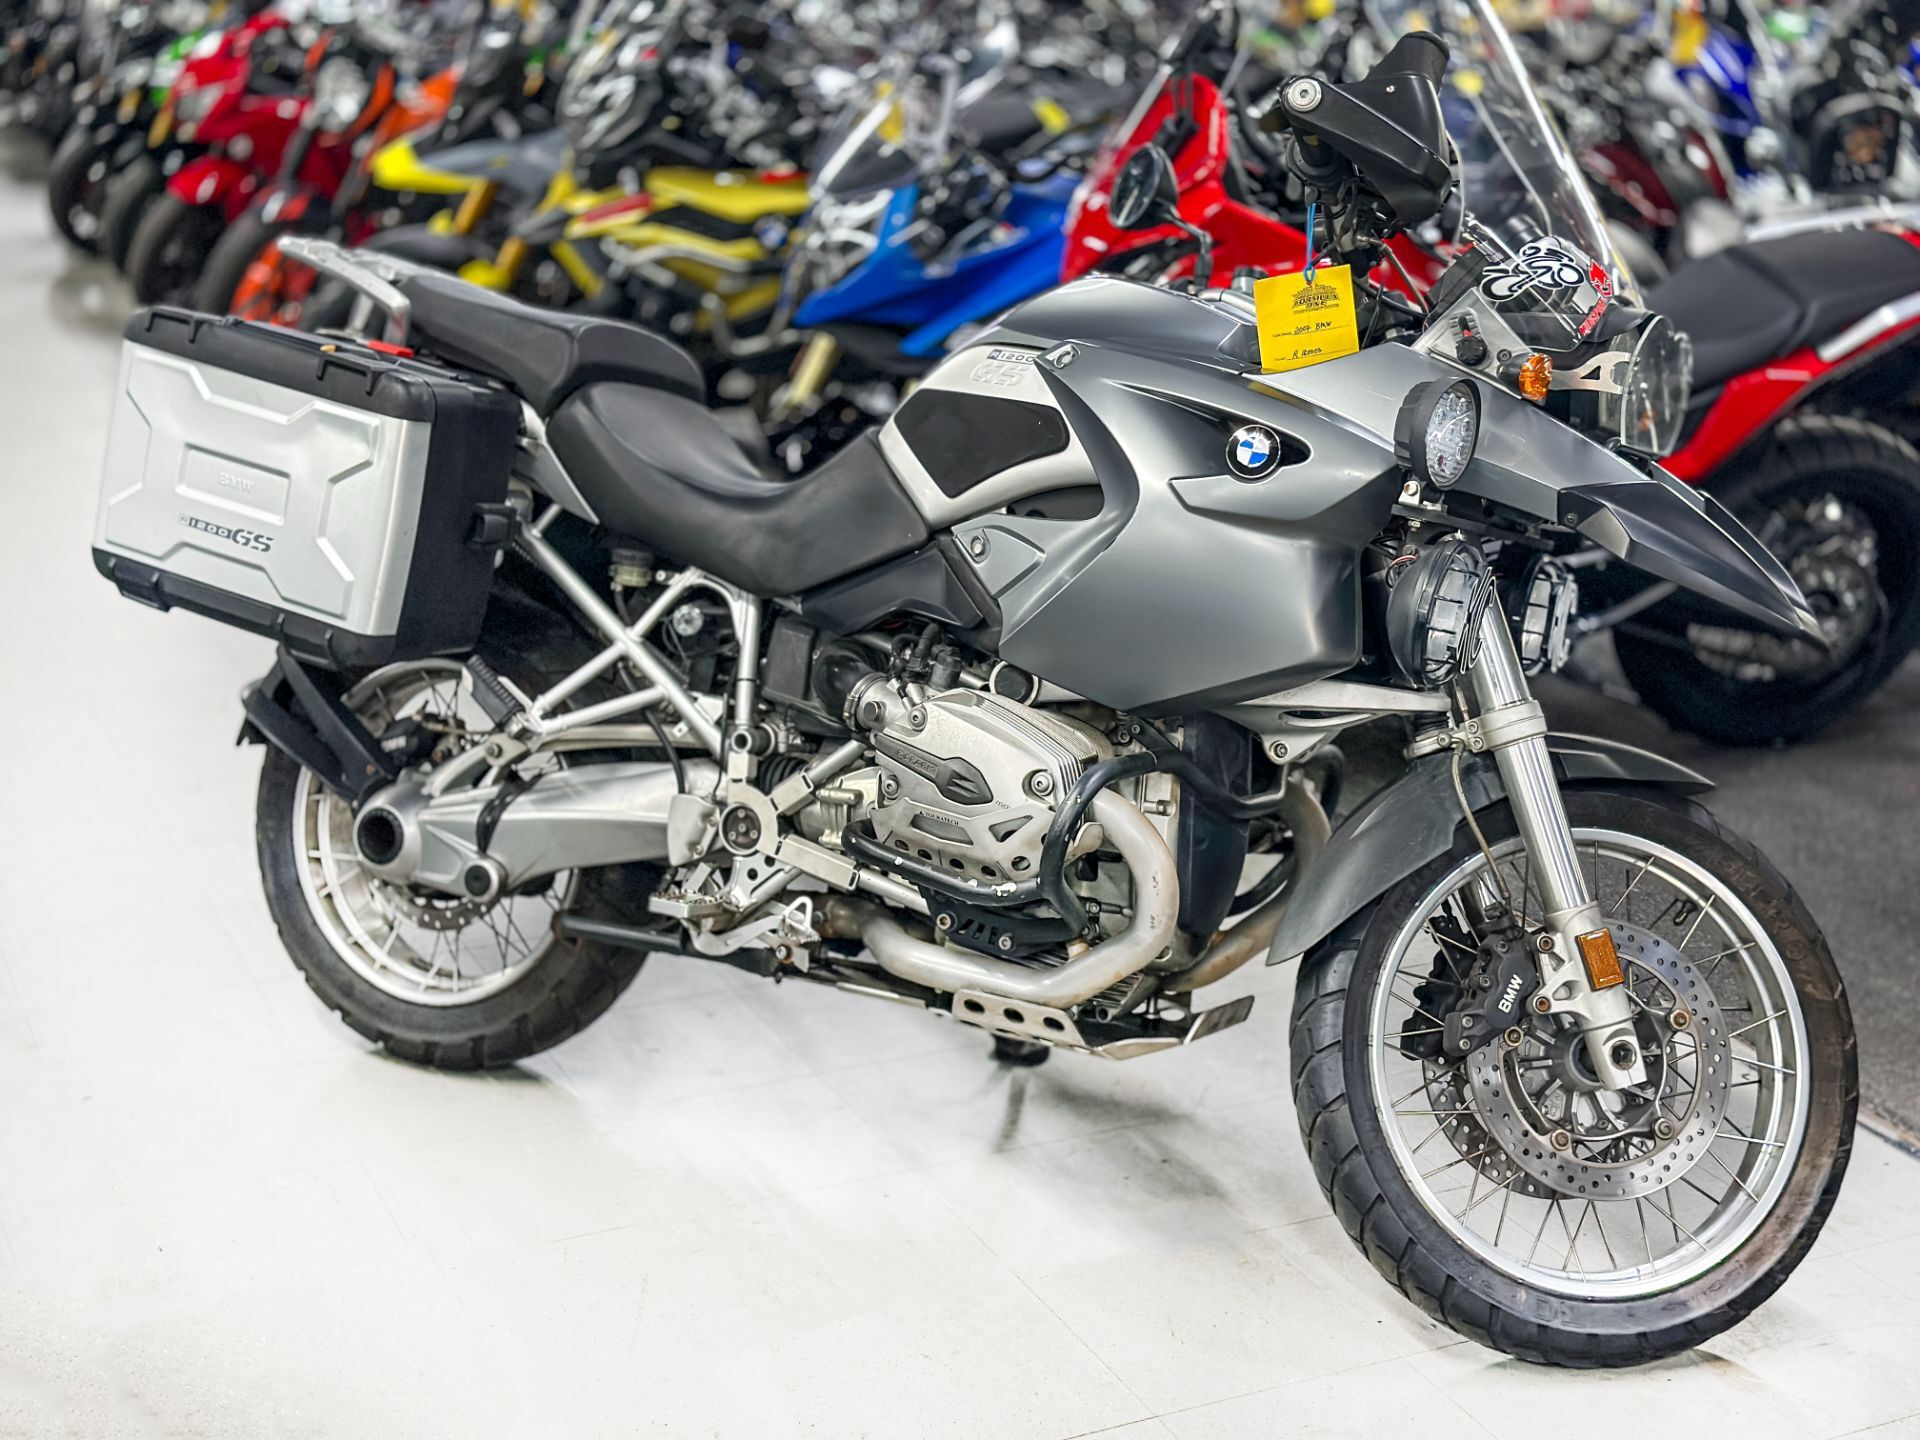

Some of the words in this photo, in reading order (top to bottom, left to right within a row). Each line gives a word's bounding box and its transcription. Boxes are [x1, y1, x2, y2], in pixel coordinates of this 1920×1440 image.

[1315, 321, 1332, 330] BMW
[970, 361, 1030, 387] GS
[1498, 973, 1523, 1013] BMW
